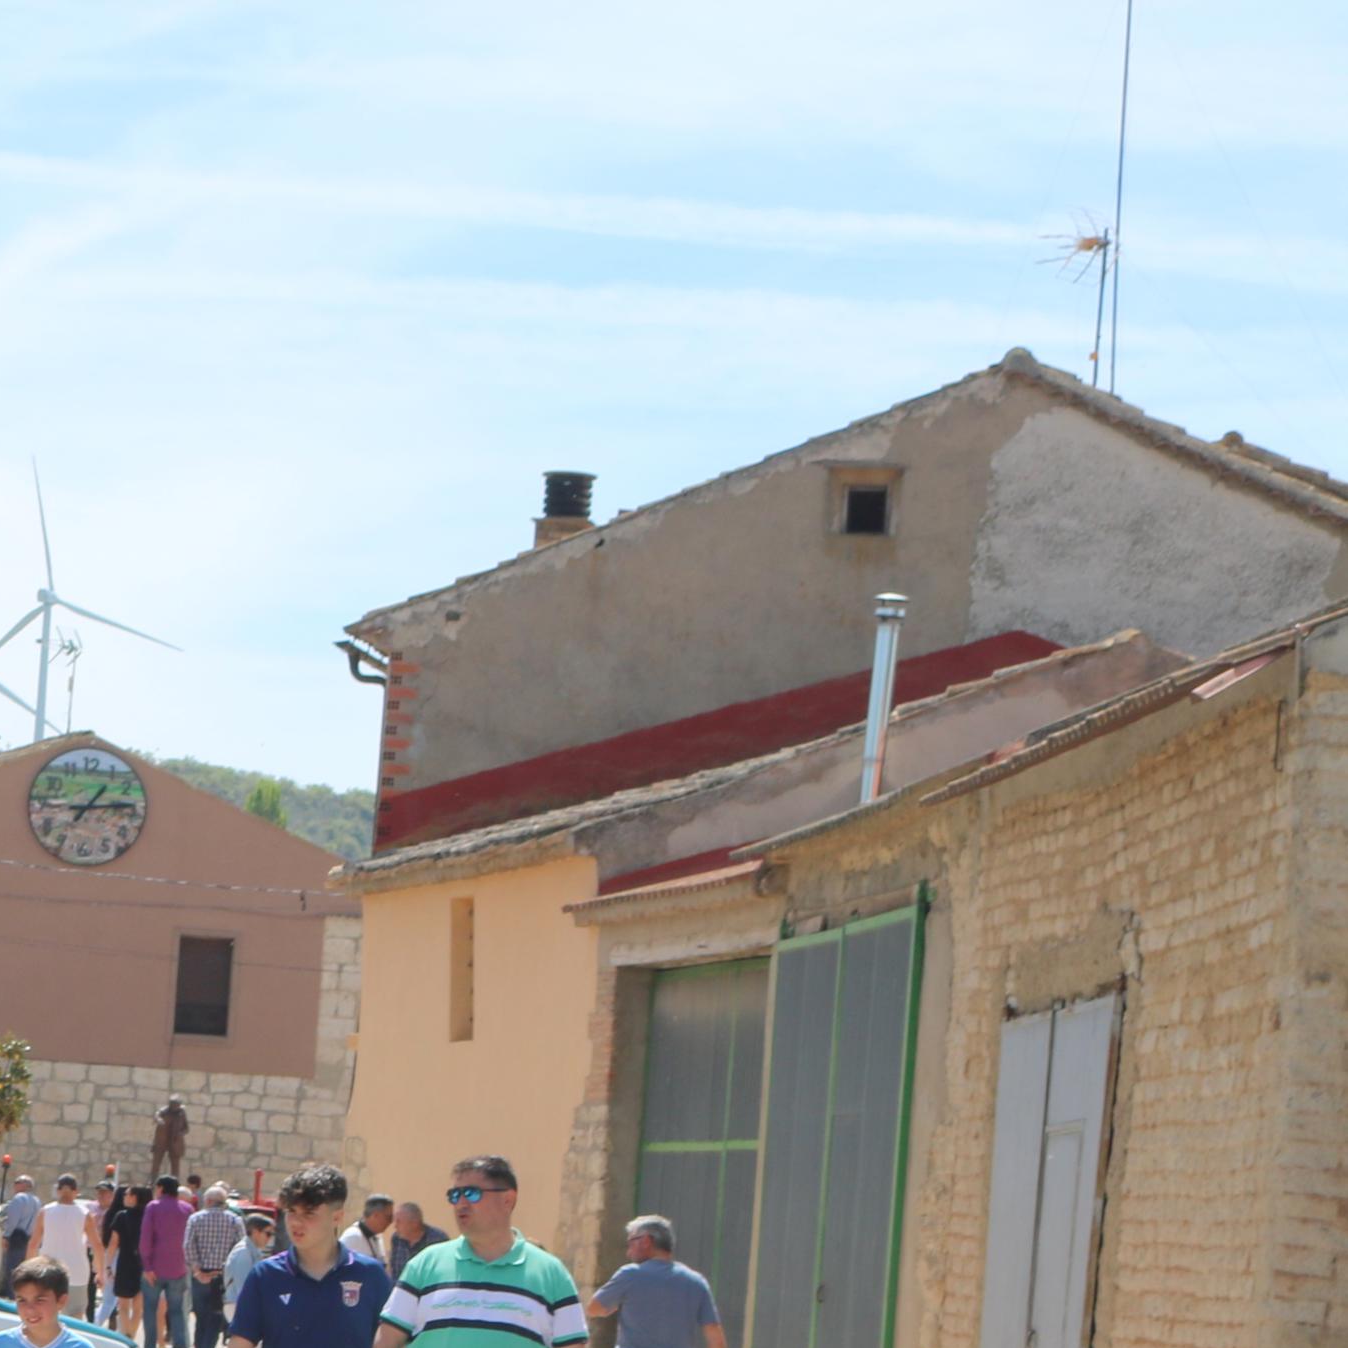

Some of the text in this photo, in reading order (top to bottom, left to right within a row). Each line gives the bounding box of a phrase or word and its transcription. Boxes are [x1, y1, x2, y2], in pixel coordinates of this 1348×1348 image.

[63, 761, 76, 777] 11
[83, 756, 100, 772] 12
[121, 780, 131, 795] 2
[99, 838, 110, 854] 5
